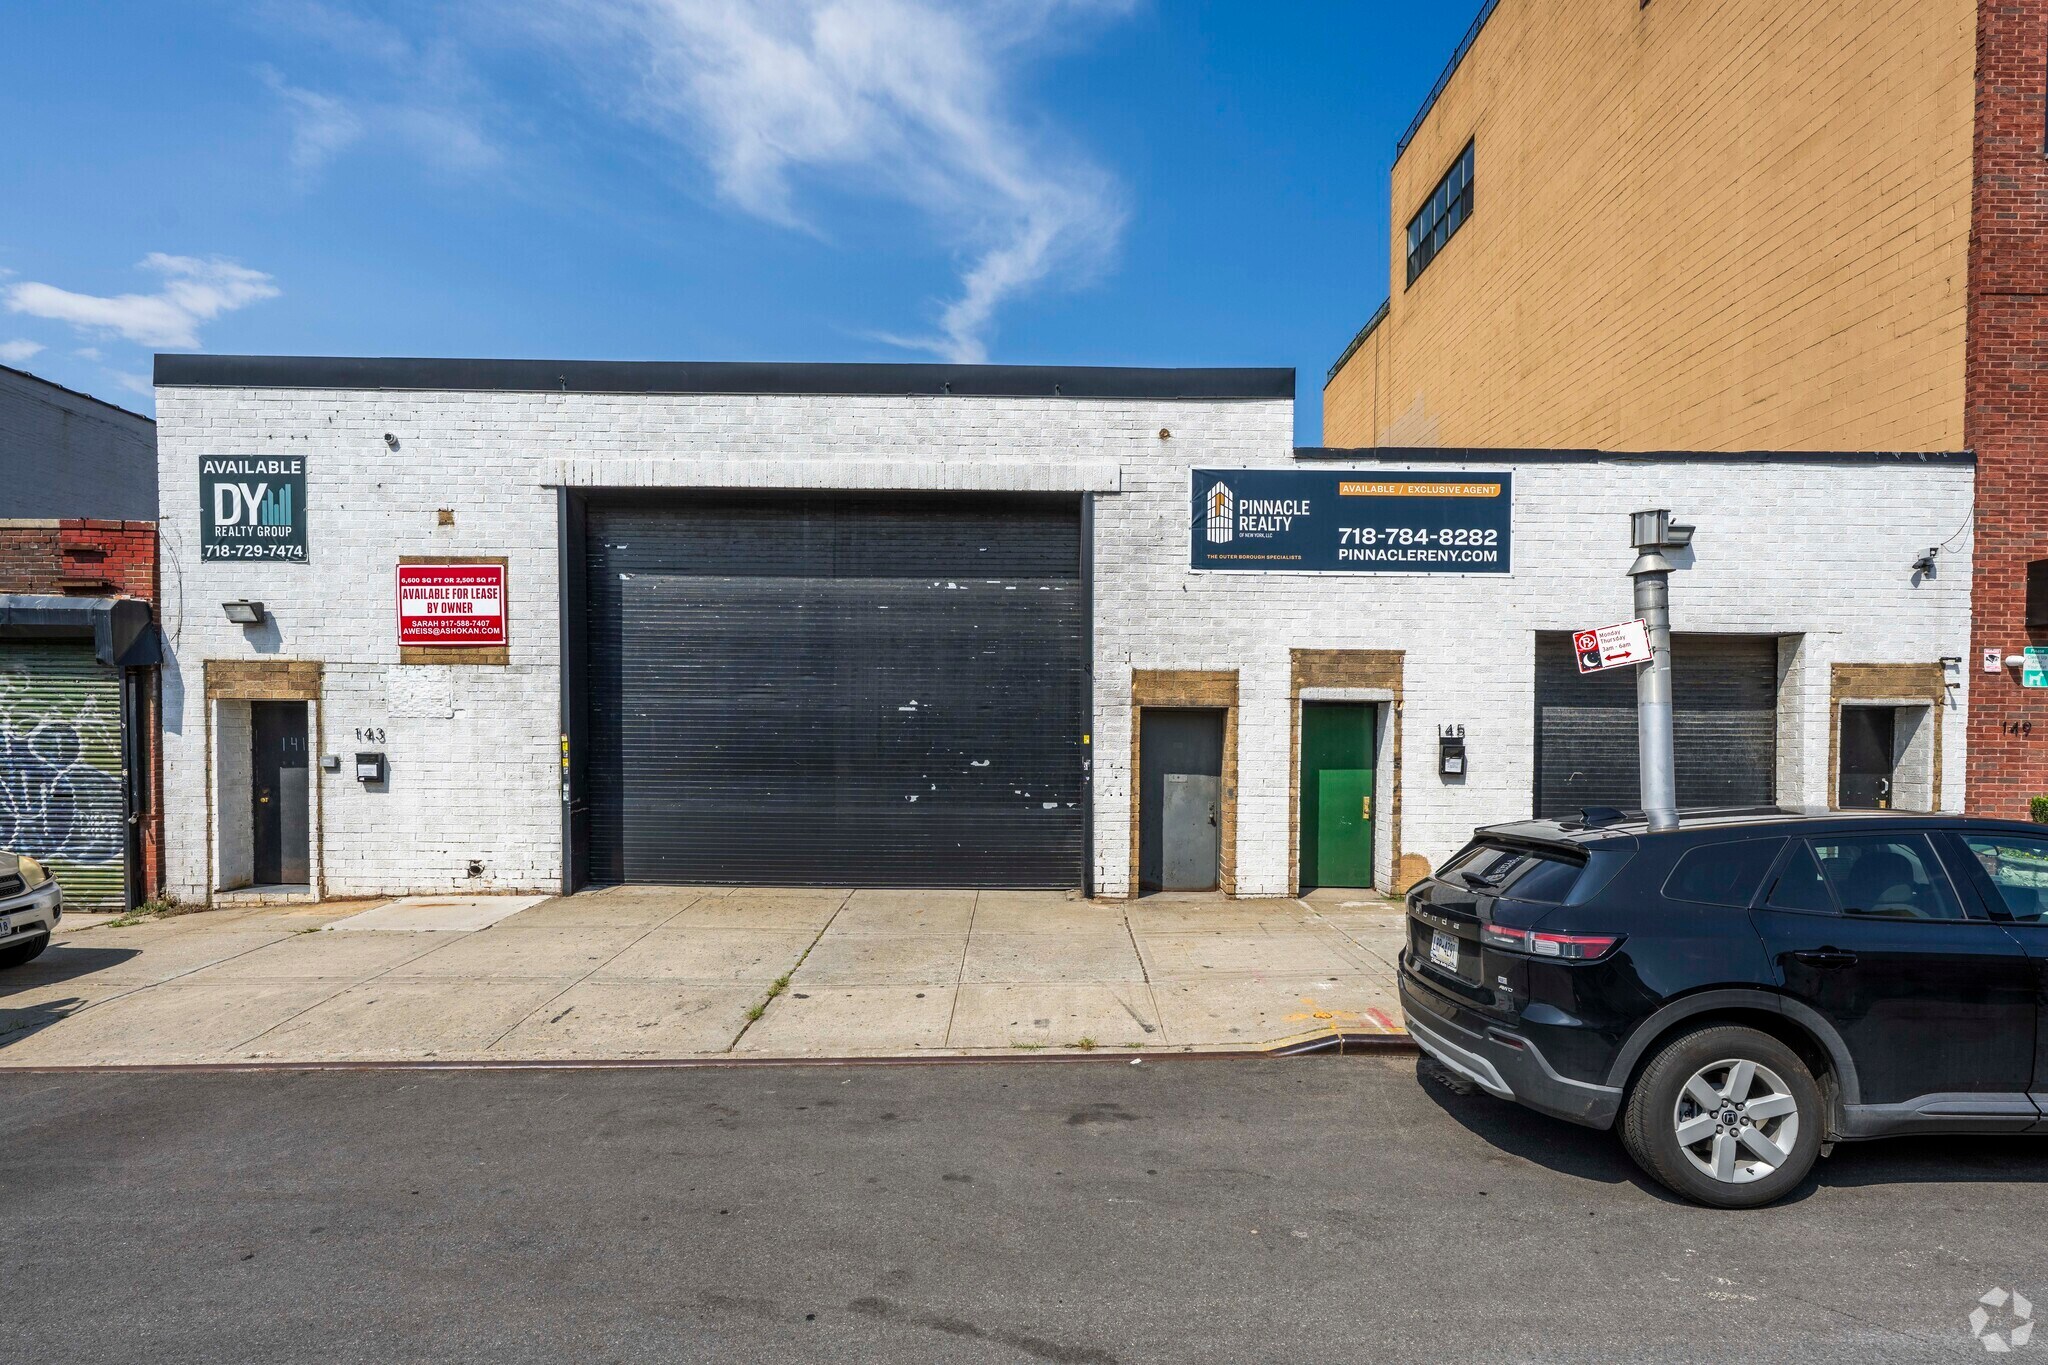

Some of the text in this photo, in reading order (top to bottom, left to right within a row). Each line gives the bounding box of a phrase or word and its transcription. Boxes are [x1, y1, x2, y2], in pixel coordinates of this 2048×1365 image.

[203, 460, 301, 474] AVAILABLE
[1342, 485, 1395, 493] AVAILABLE
[1408, 485, 1461, 494] EXCLUSIVE
[1463, 486, 1496, 494] AGENT
[213, 482, 268, 526] DY
[1239, 499, 1310, 516] PINNACLE
[1239, 516, 1292, 532] REALTY
[215, 526, 292, 537] REALTY GROUP
[1338, 527, 1498, 546] 718-784-8282
[204, 545, 303, 557] 718-729-7474
[1338, 548, 1497, 562] PINNACLERENY.COM
[402, 587, 498, 600] AVAILABLE FOR LEASE
[427, 602, 473, 614] BY OWNER
[403, 627, 500, 636] AWEISS@ASHOKAN.COM
[1599, 630, 1620, 638] Monday
[1601, 635, 1625, 643] Thursday
[354, 727, 386, 743] 143
[1437, 723, 1465, 737] 145
[2002, 721, 2032, 737] 149
[282, 736, 306, 751] 141
